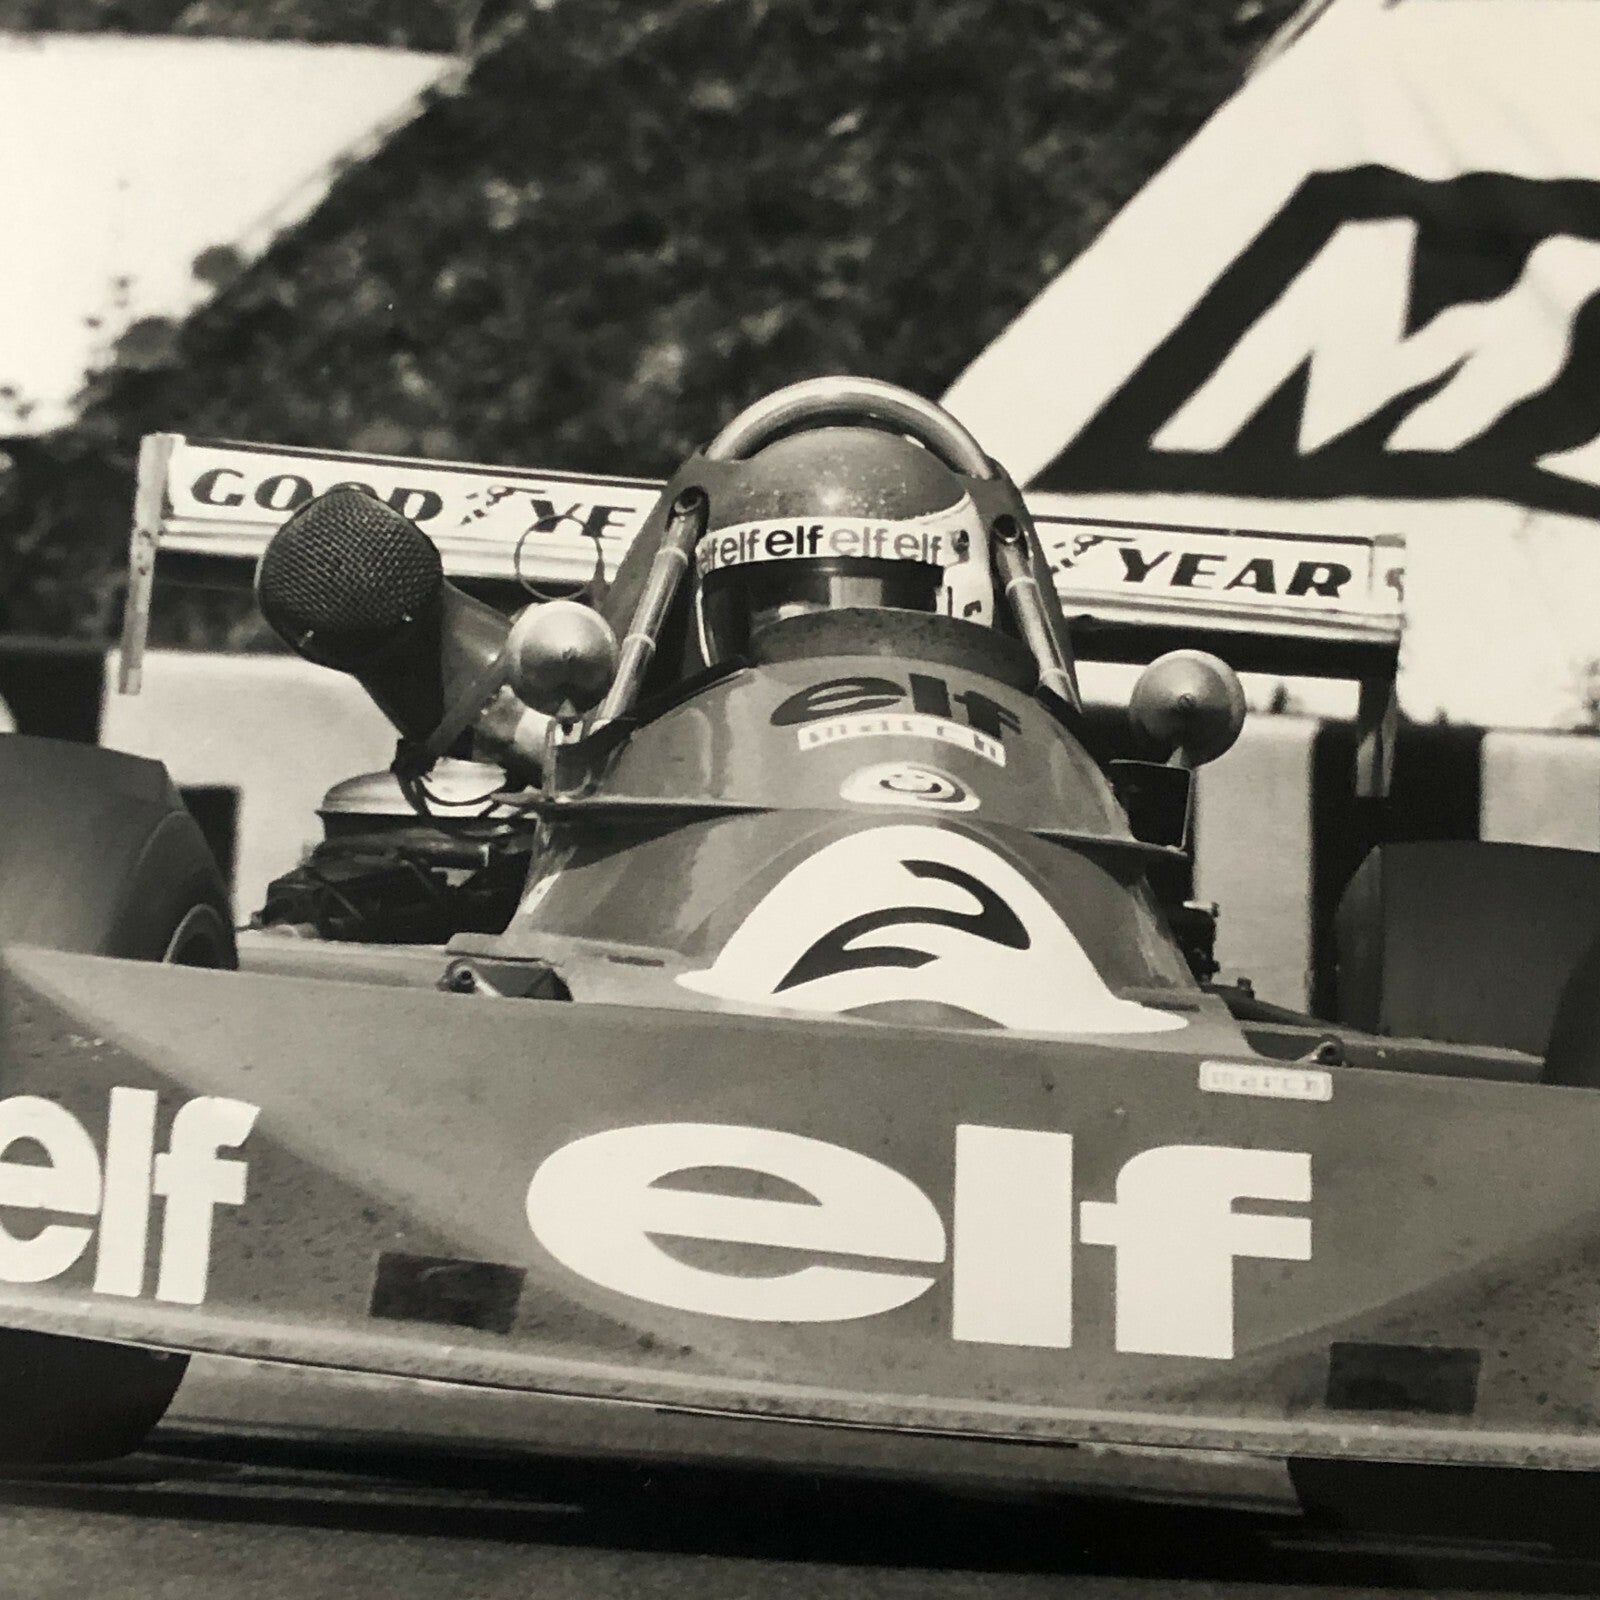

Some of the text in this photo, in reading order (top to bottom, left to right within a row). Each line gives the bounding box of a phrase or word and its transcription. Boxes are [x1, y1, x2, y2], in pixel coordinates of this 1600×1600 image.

[720, 528, 761, 566] elf
[764, 524, 824, 557] elf
[828, 526, 889, 557] elf
[893, 532, 943, 565] elf
[1117, 546, 1353, 599] YEAR
[769, 675, 1023, 742] elf
[771, 859, 1032, 995] 2
[0, 1086, 261, 1305] elf
[526, 1122, 1313, 1360] elf
